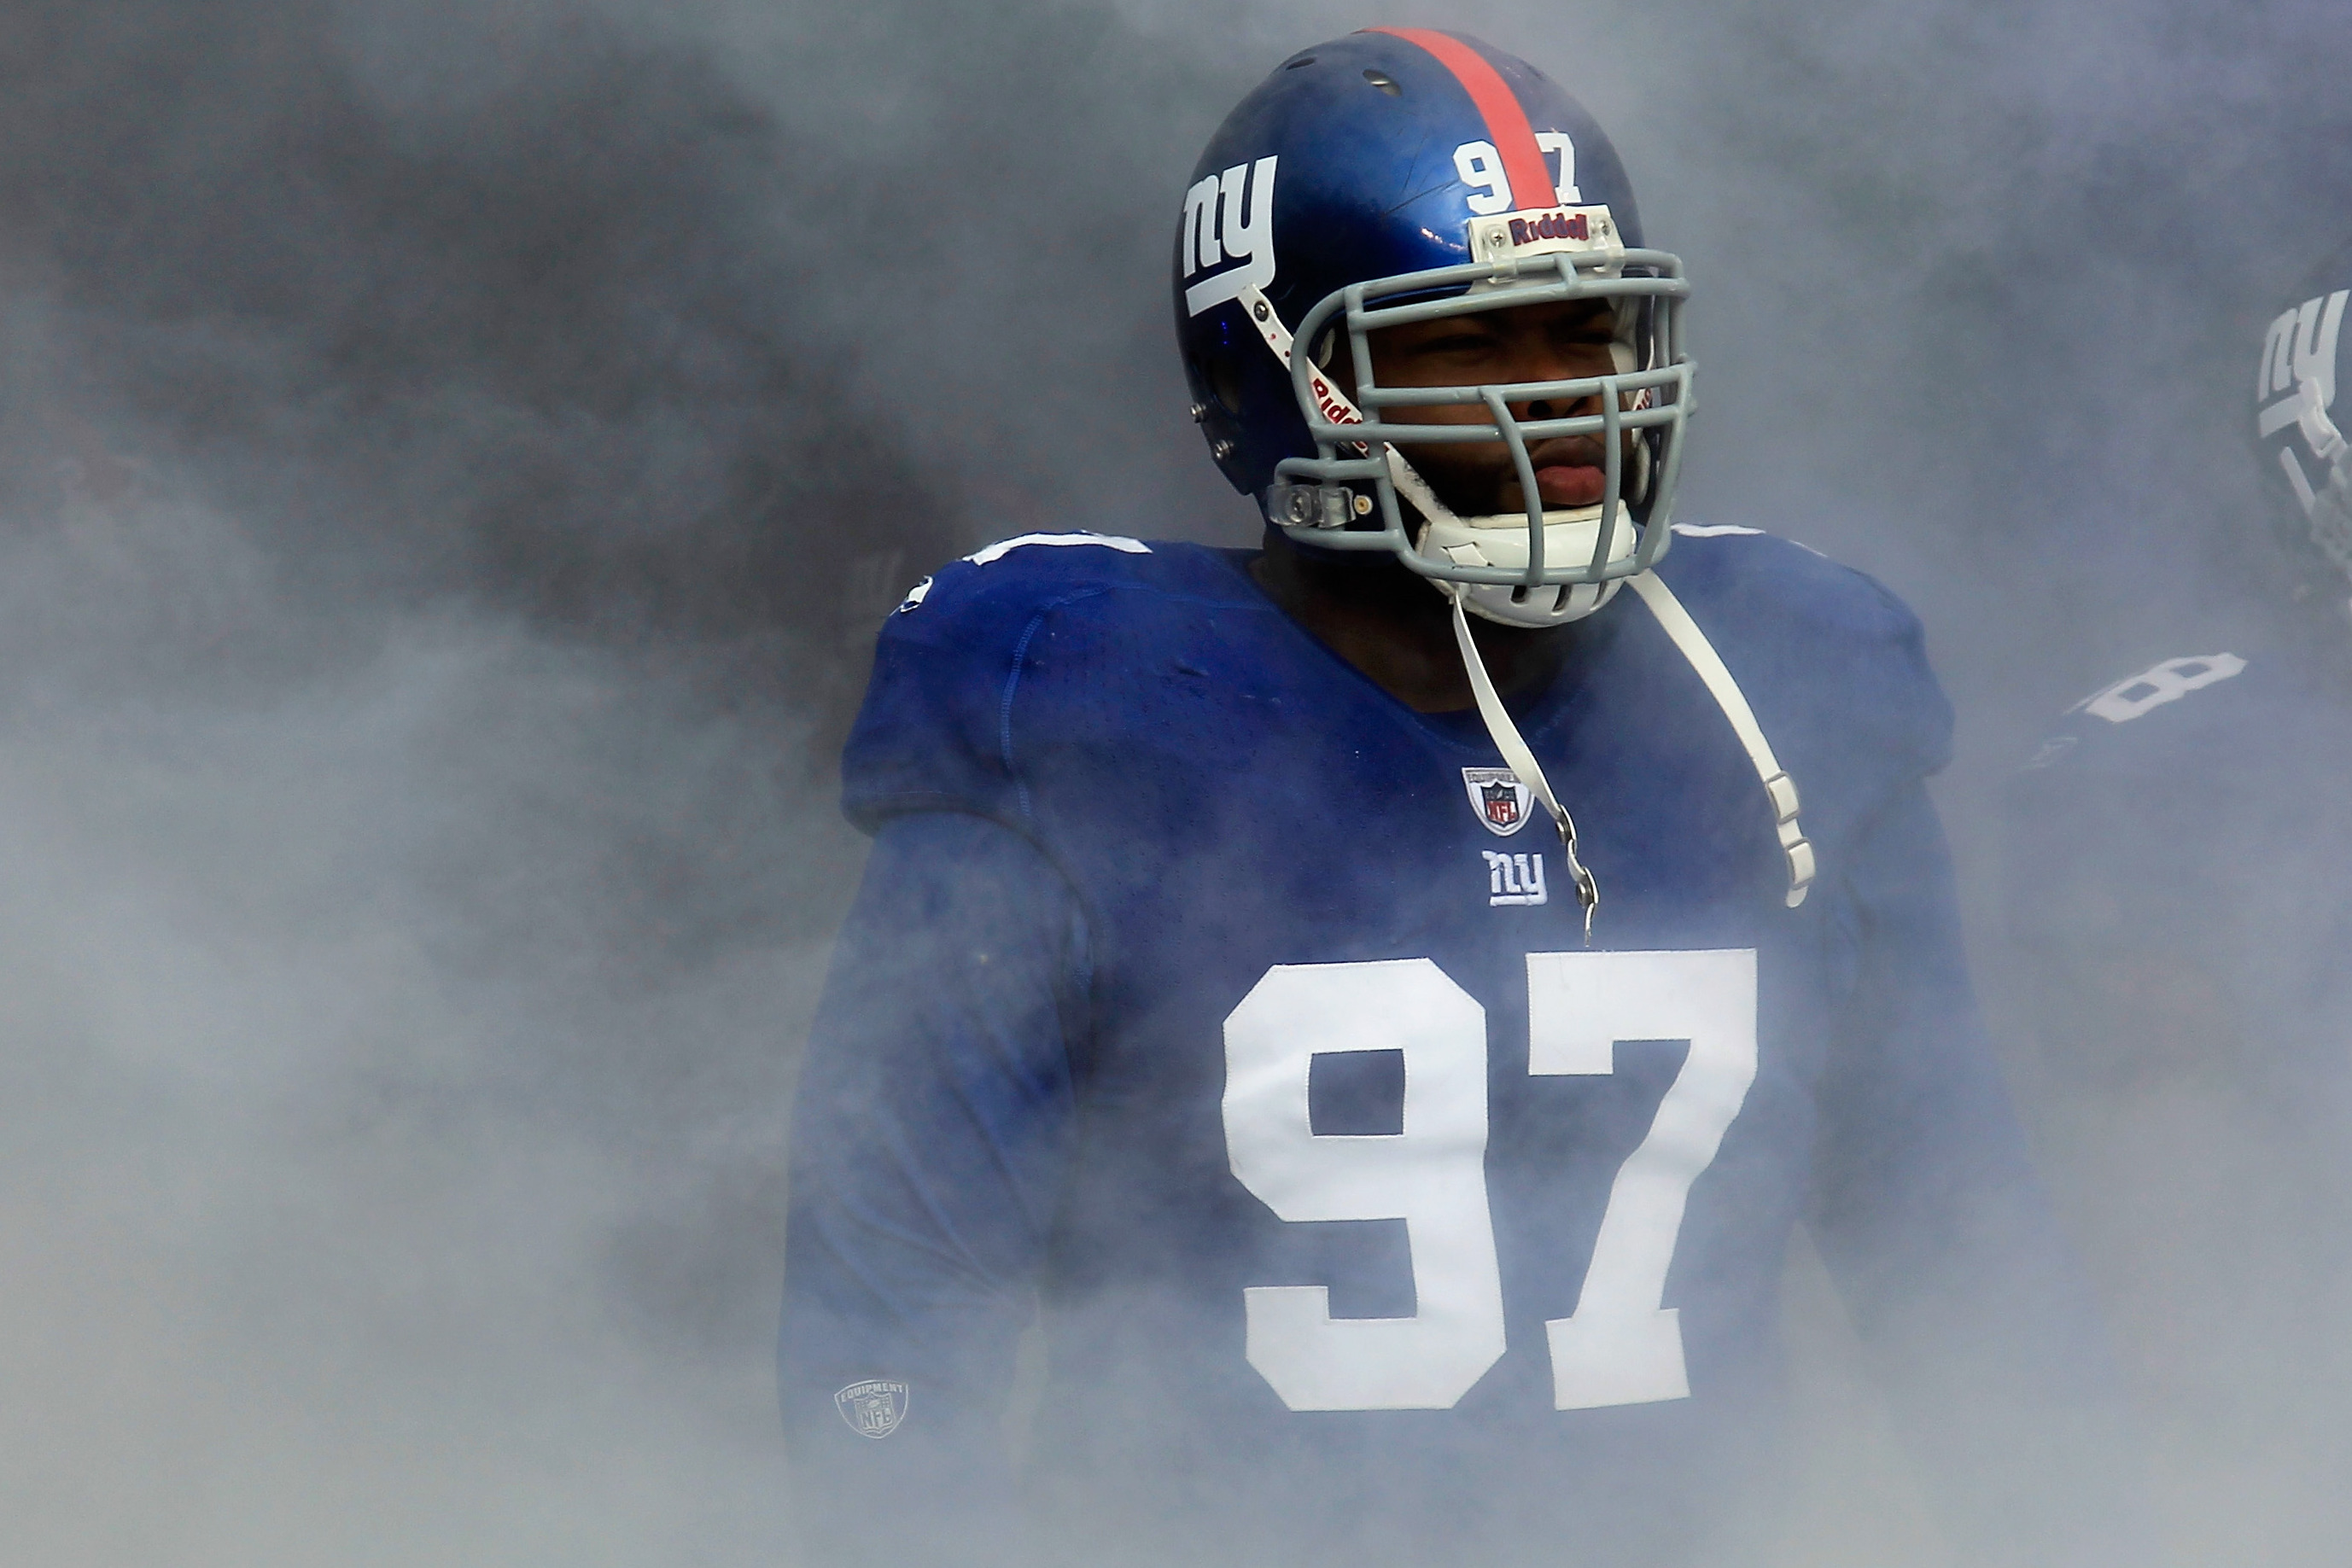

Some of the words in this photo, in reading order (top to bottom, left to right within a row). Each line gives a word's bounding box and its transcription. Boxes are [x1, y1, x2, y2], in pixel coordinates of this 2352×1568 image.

[1453, 131, 1582, 214] 97
[1222, 948, 1758, 1411] 97
[841, 1383, 902, 1402] EQUIPMENT
[860, 1408, 893, 1430] NFL
